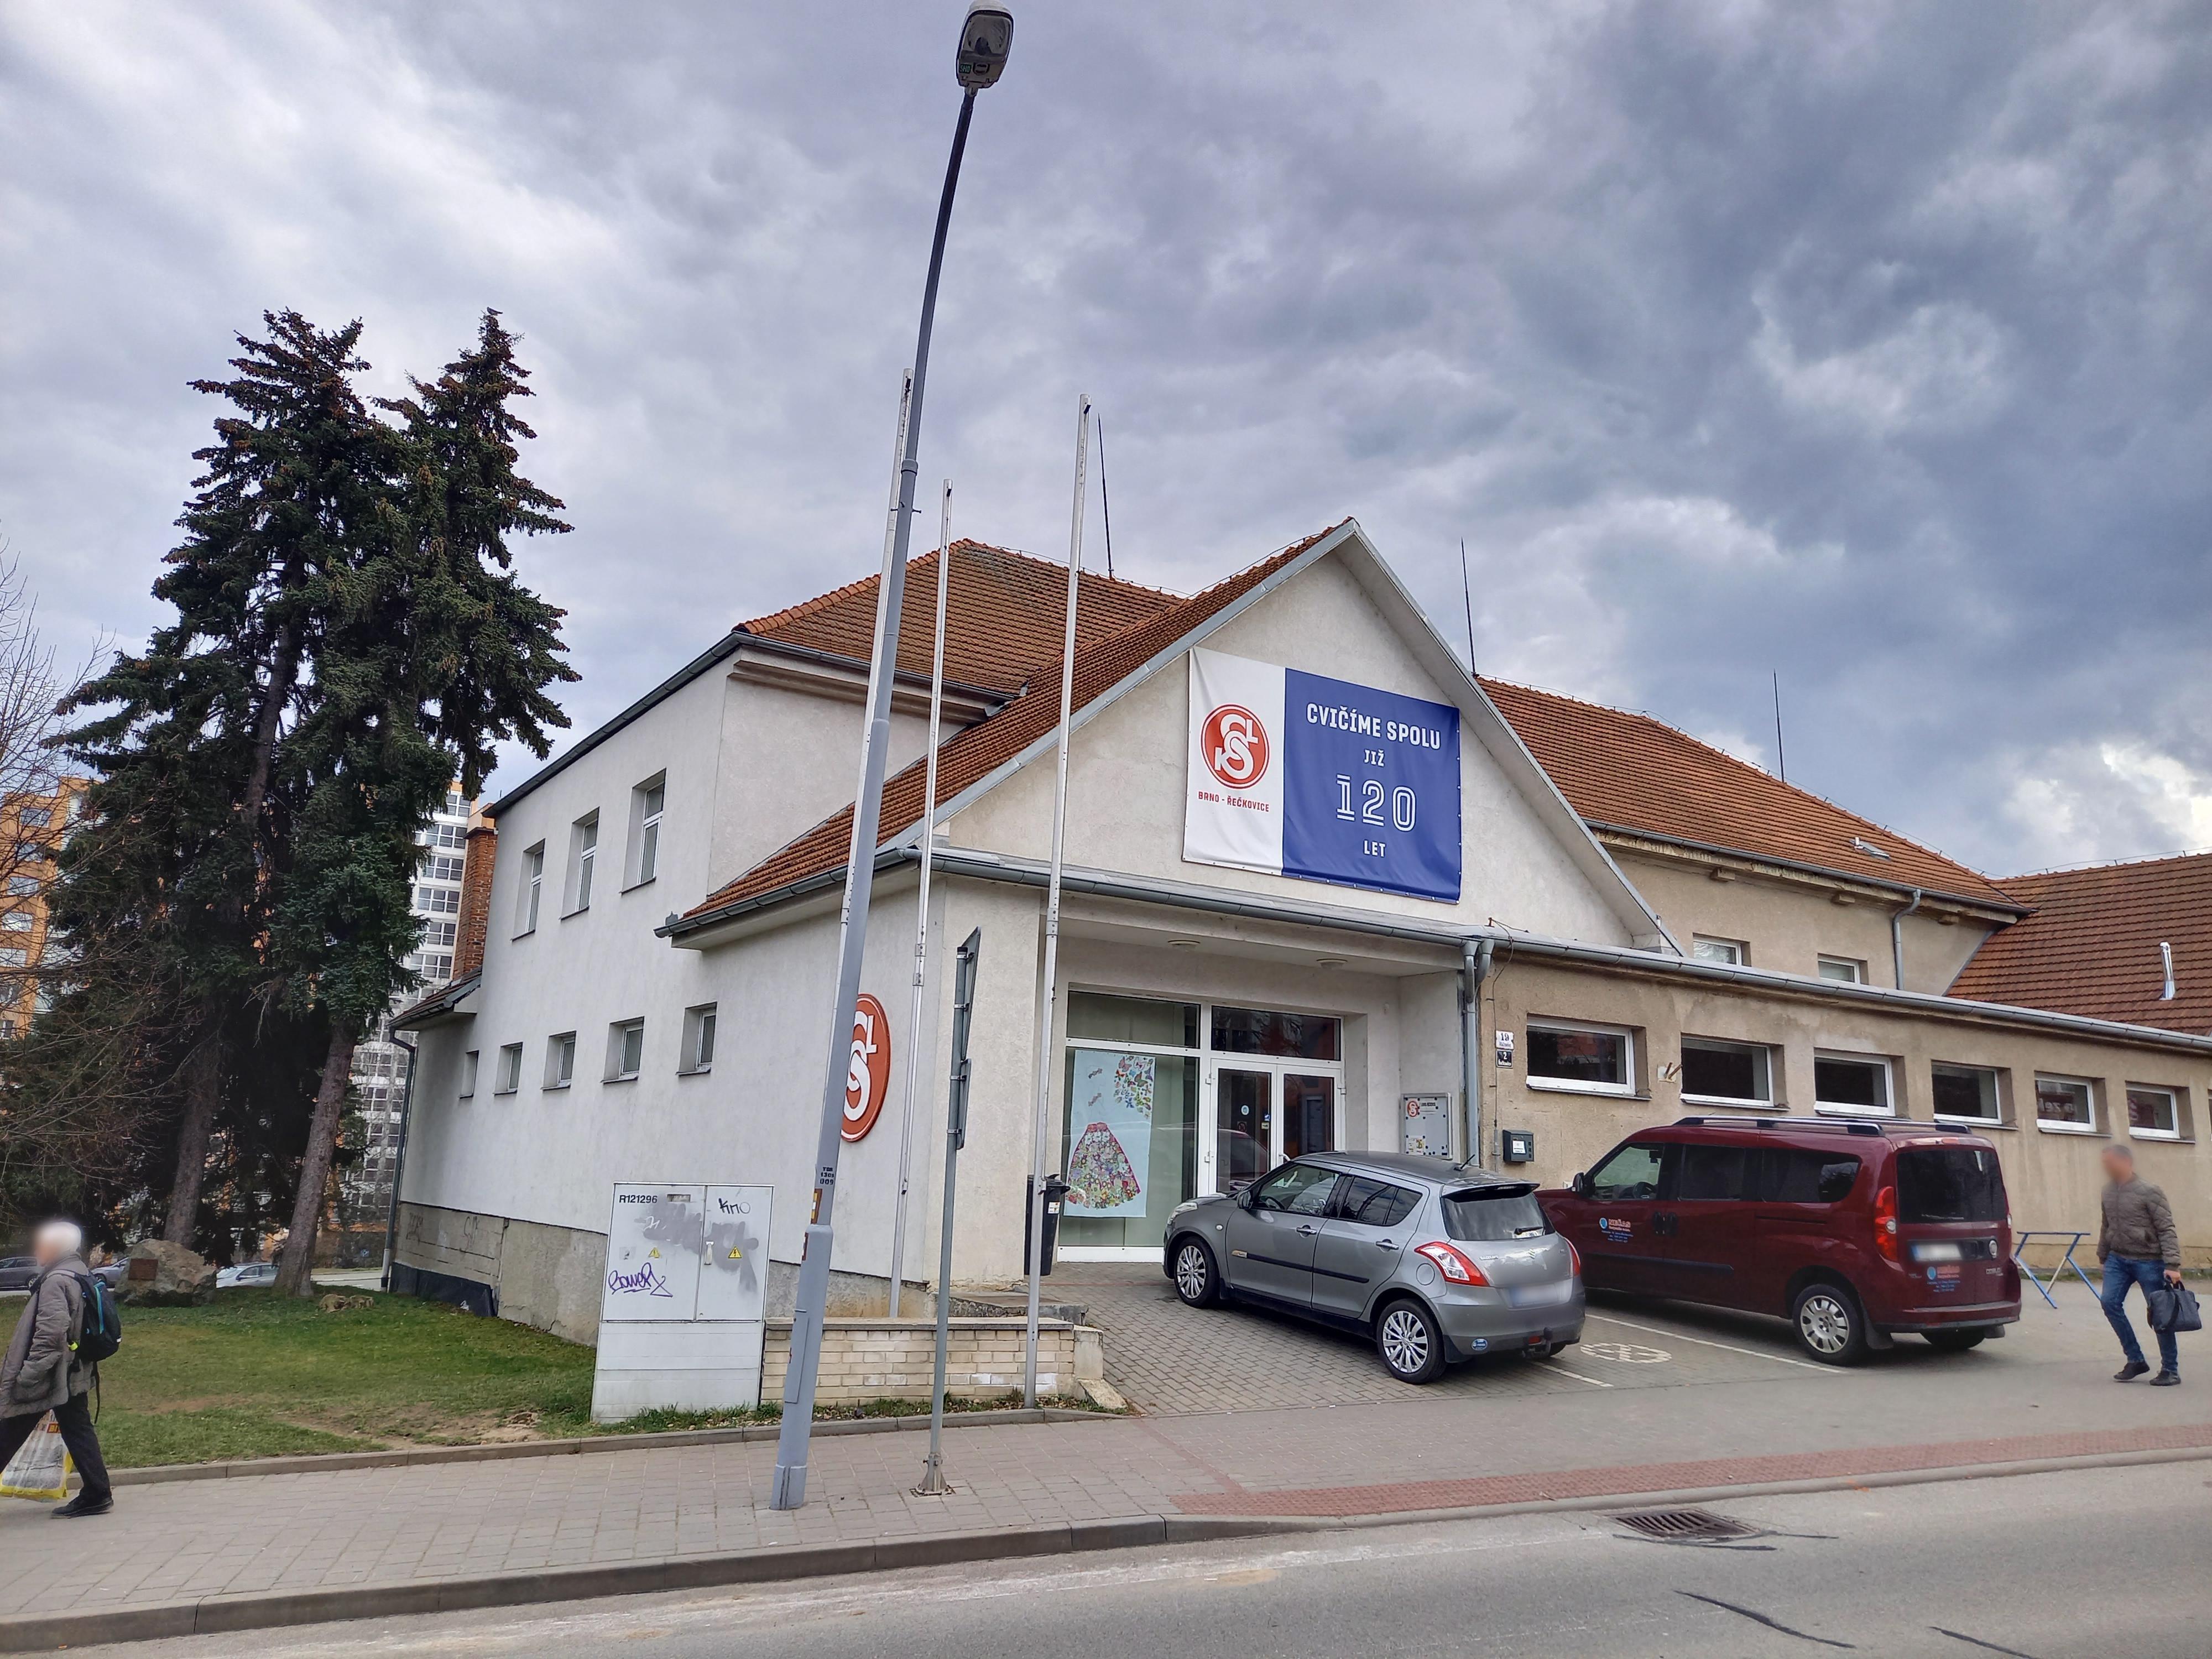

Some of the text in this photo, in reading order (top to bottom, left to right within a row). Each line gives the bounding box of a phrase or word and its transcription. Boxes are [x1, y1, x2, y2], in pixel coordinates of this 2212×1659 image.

[1306, 703, 1440, 749] CVIČÍME SPOLU
[1364, 749, 1385, 767] JIŽ
[1198, 791, 1219, 803] BRNO
[1227, 795, 1270, 812] ŘEČKOVICE
[1337, 774, 1416, 832] 120
[1364, 840, 1386, 858] LET
[1503, 1051, 1507, 1060] 2
[619, 1194, 658, 1204] R121296
